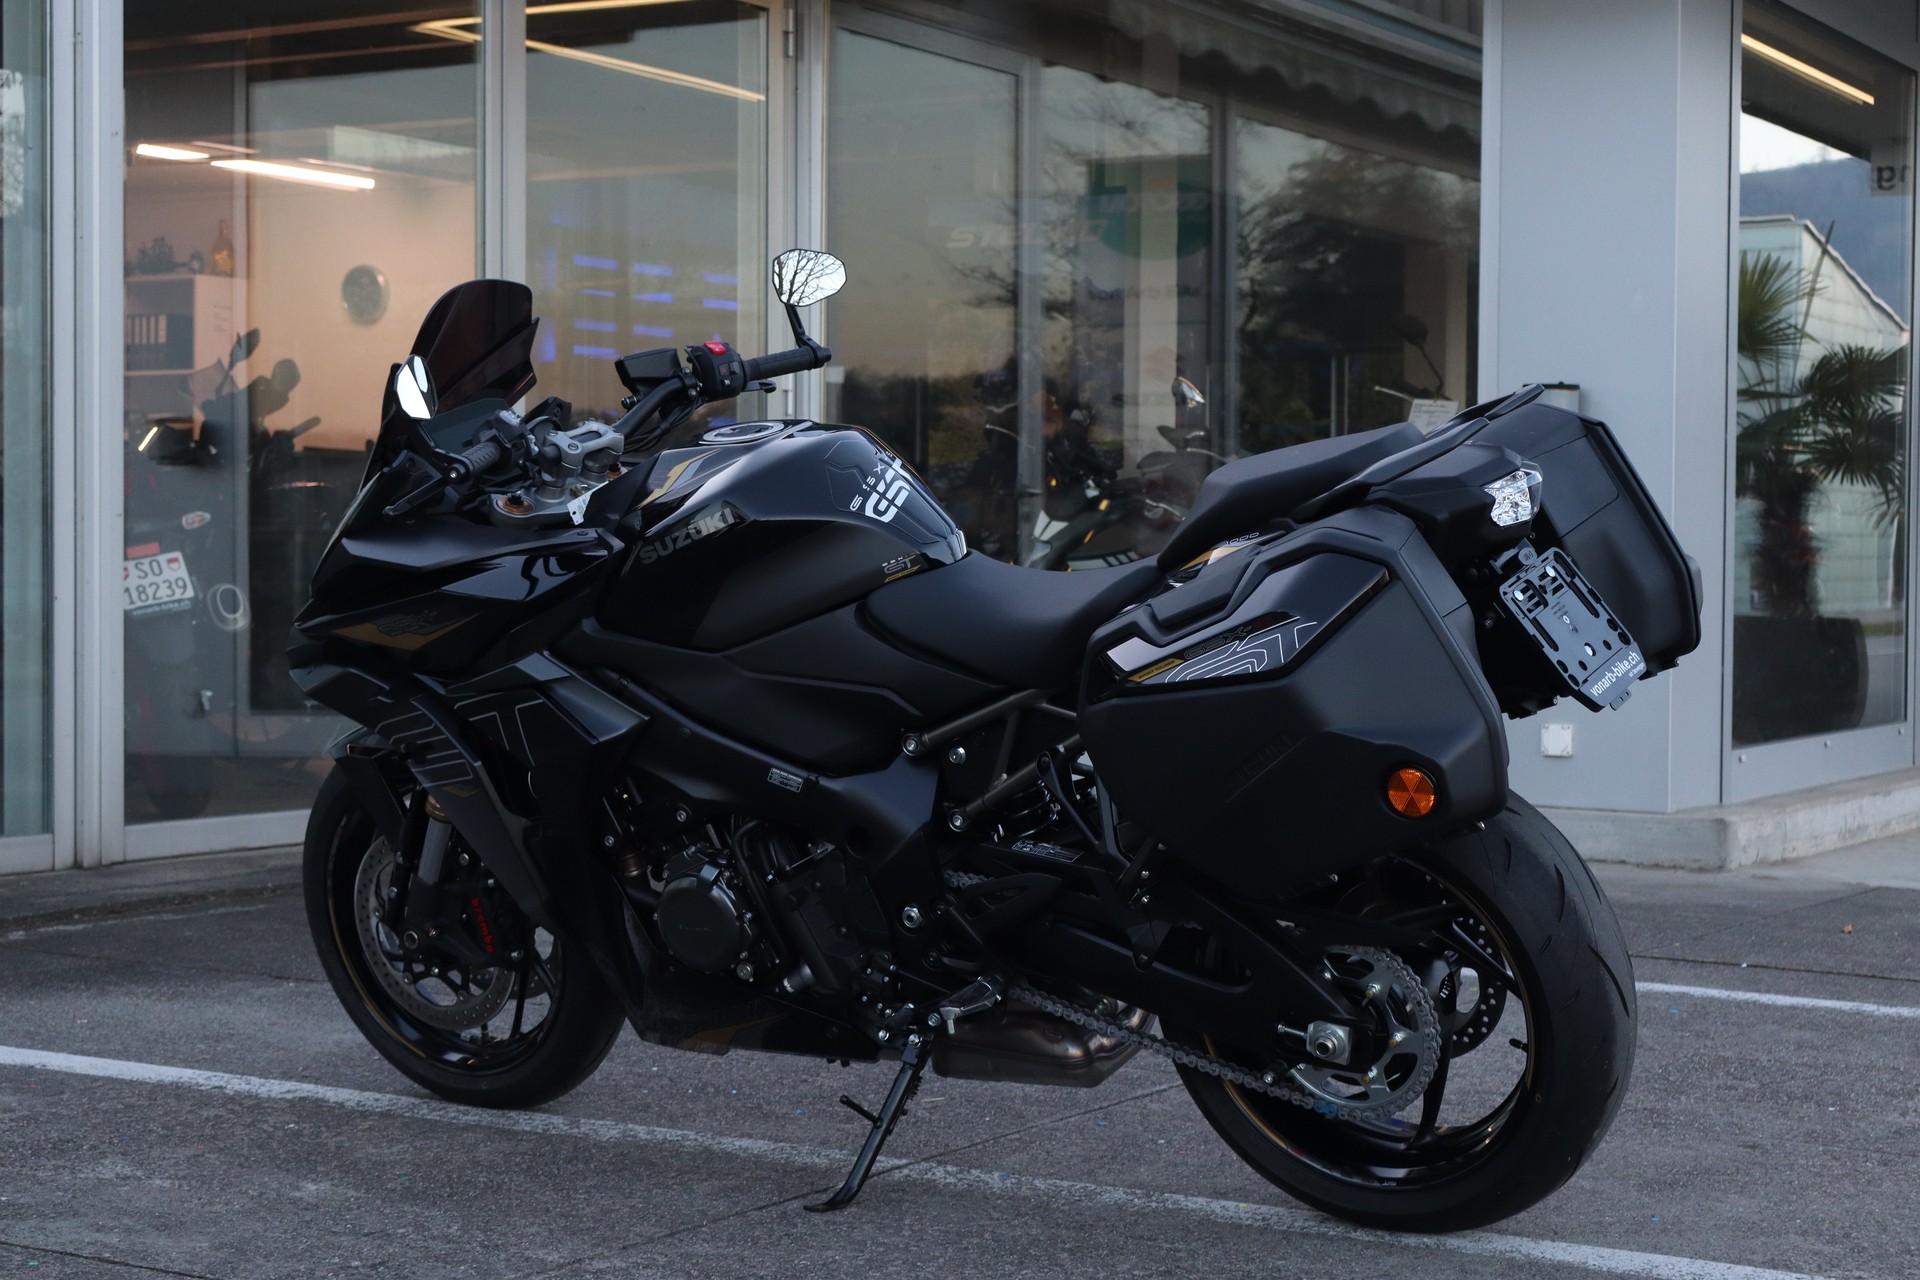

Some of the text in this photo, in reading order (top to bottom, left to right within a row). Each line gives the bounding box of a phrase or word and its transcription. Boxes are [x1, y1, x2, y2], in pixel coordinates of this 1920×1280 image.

[640, 507, 735, 565] SUZUKI
[123, 577, 188, 606] 18239
[135, 558, 163, 580] SO
[1589, 650, 1641, 697] vonarb-bike.ch
[470, 897, 495, 955] brembo
